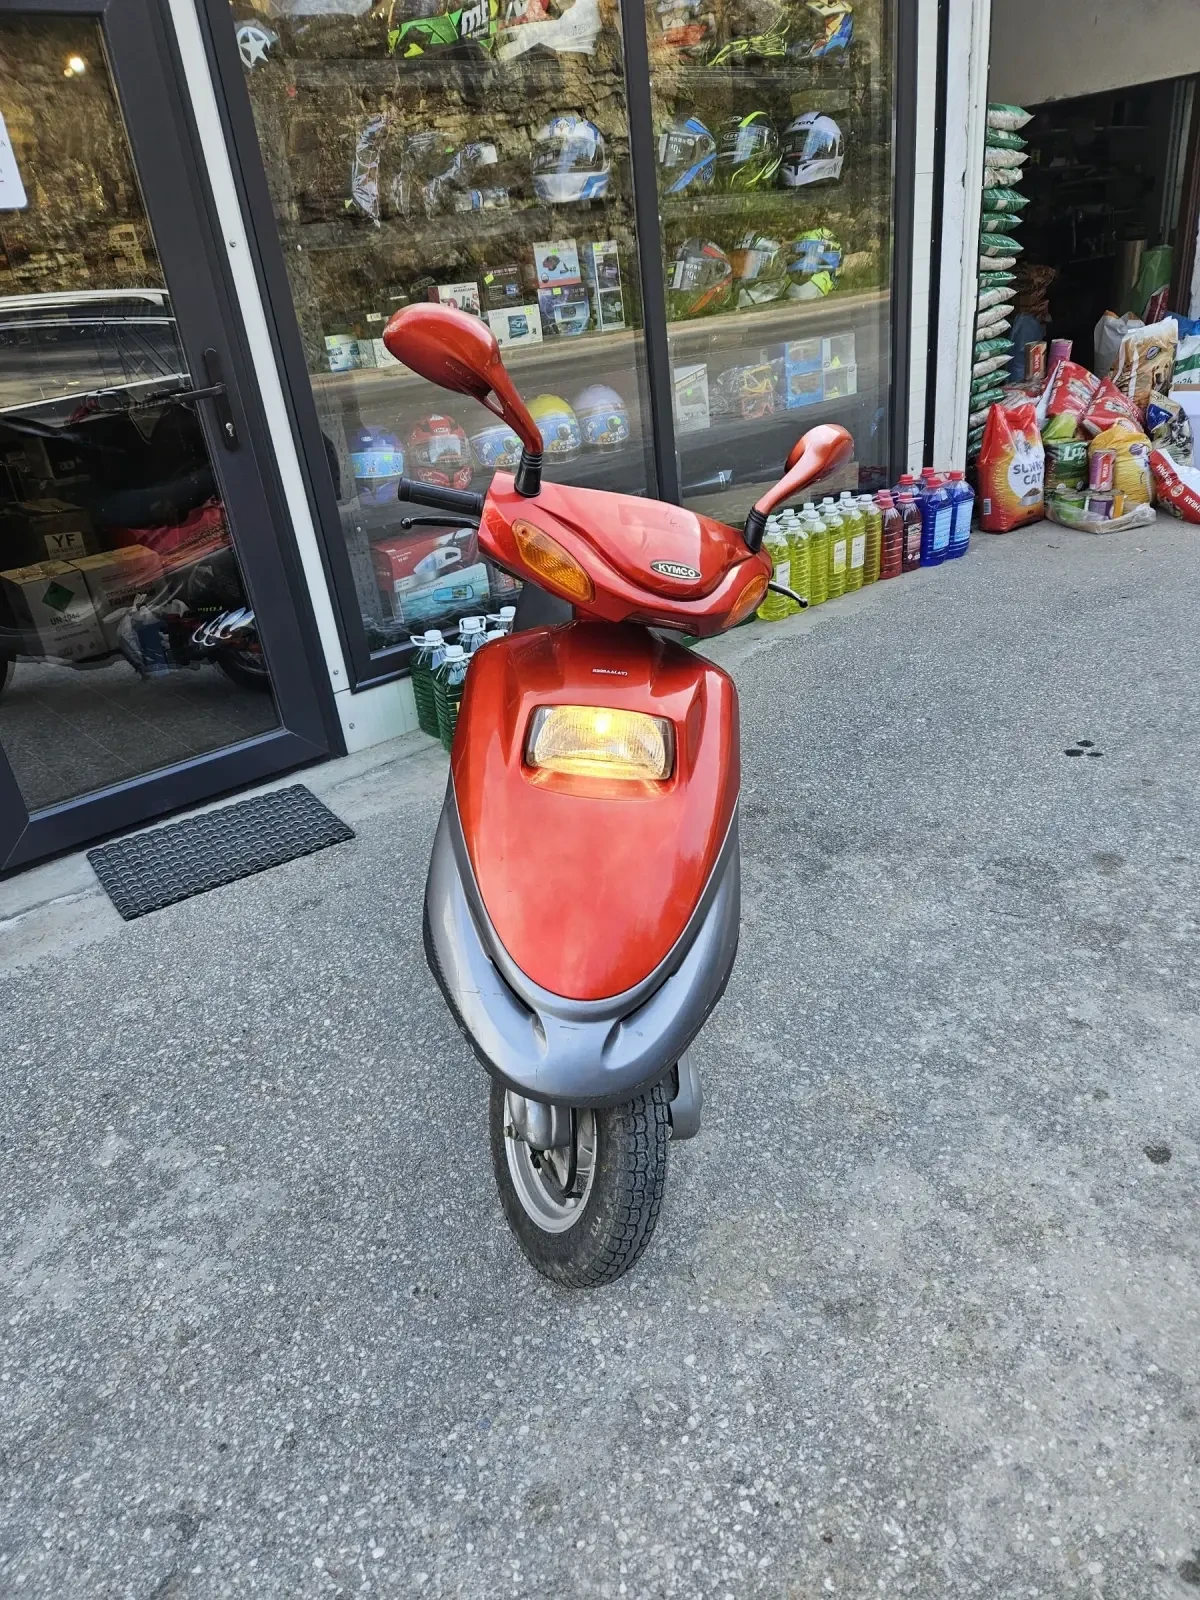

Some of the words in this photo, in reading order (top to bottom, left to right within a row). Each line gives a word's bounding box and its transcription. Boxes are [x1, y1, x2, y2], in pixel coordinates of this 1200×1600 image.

[1023, 472, 1042, 485] CAT
[52, 533, 77, 548] YF
[658, 563, 696, 577] KYMCO
